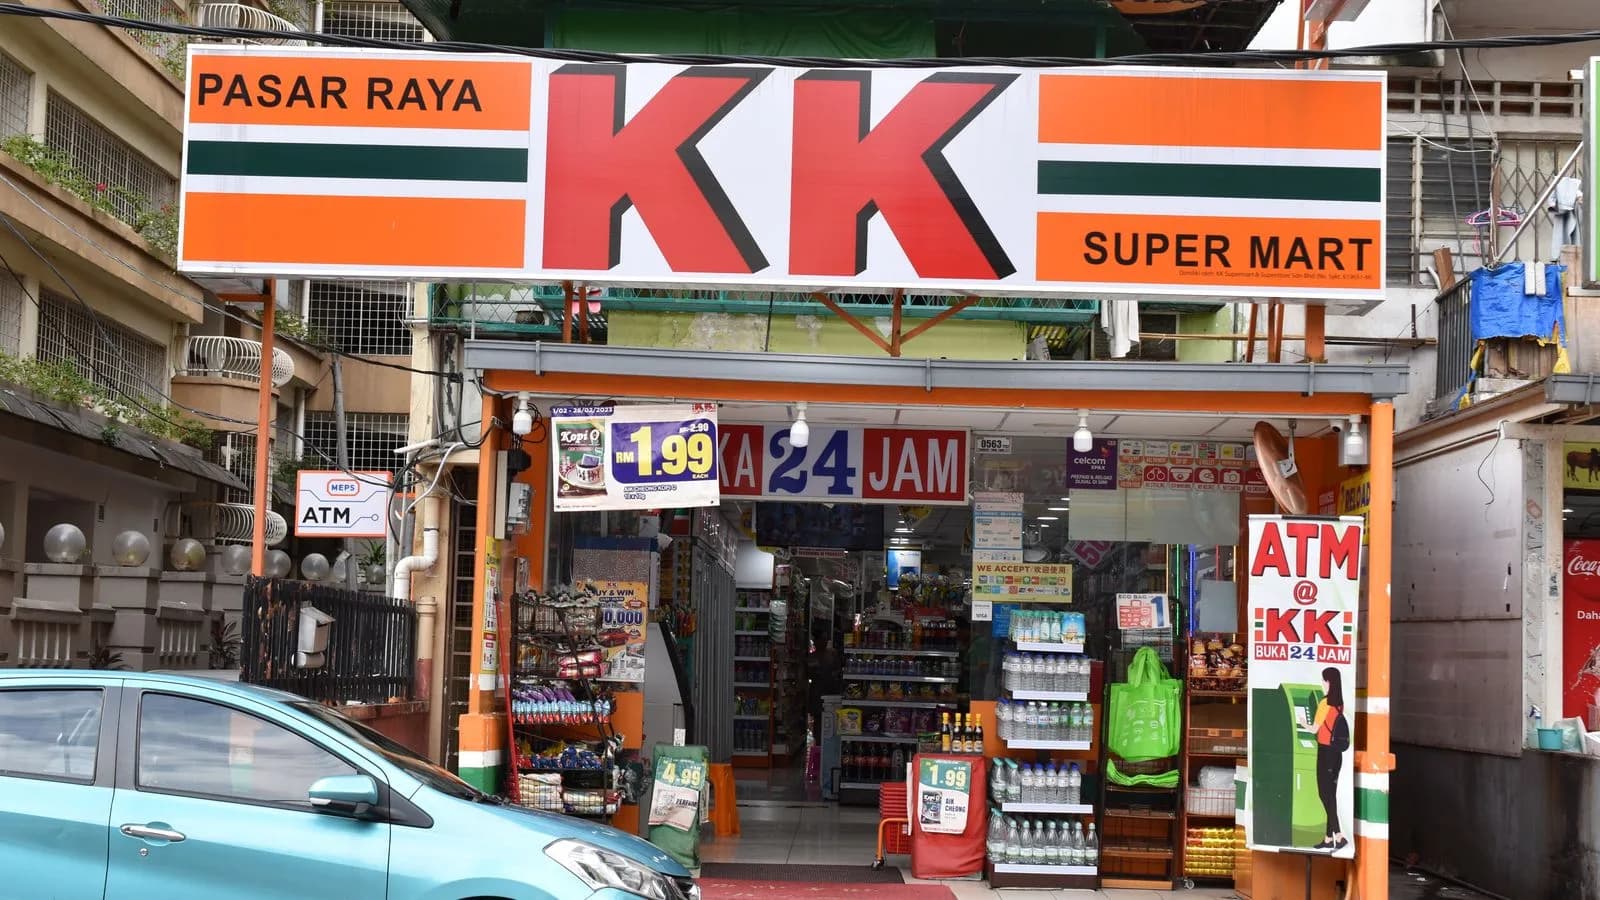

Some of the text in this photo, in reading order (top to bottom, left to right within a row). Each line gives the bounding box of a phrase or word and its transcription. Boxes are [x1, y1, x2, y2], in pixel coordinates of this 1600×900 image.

[197, 73, 483, 113] PASAR RAYA
[542, 63, 1020, 281] KK
[1083, 231, 1373, 271] SUPER MART
[560, 430, 589, 443] Kopi
[981, 439, 1002, 449] 0563
[615, 425, 714, 477] RM 1.99
[768, 429, 857, 495] 24
[869, 437, 958, 493] JAM
[1073, 457, 1106, 465] celcom
[331, 484, 356, 492] MEPS
[302, 507, 351, 524] ATM
[1250, 521, 1361, 581] ATM
[976, 564, 992, 572] WE
[994, 565, 1030, 573] ACCEPT
[1293, 580, 1318, 606] @
[1266, 608, 1340, 645] KK
[1256, 645, 1350, 662] BUKA 24 JAM
[662, 763, 701, 786] 4.99
[929, 764, 967, 787] 1.99
